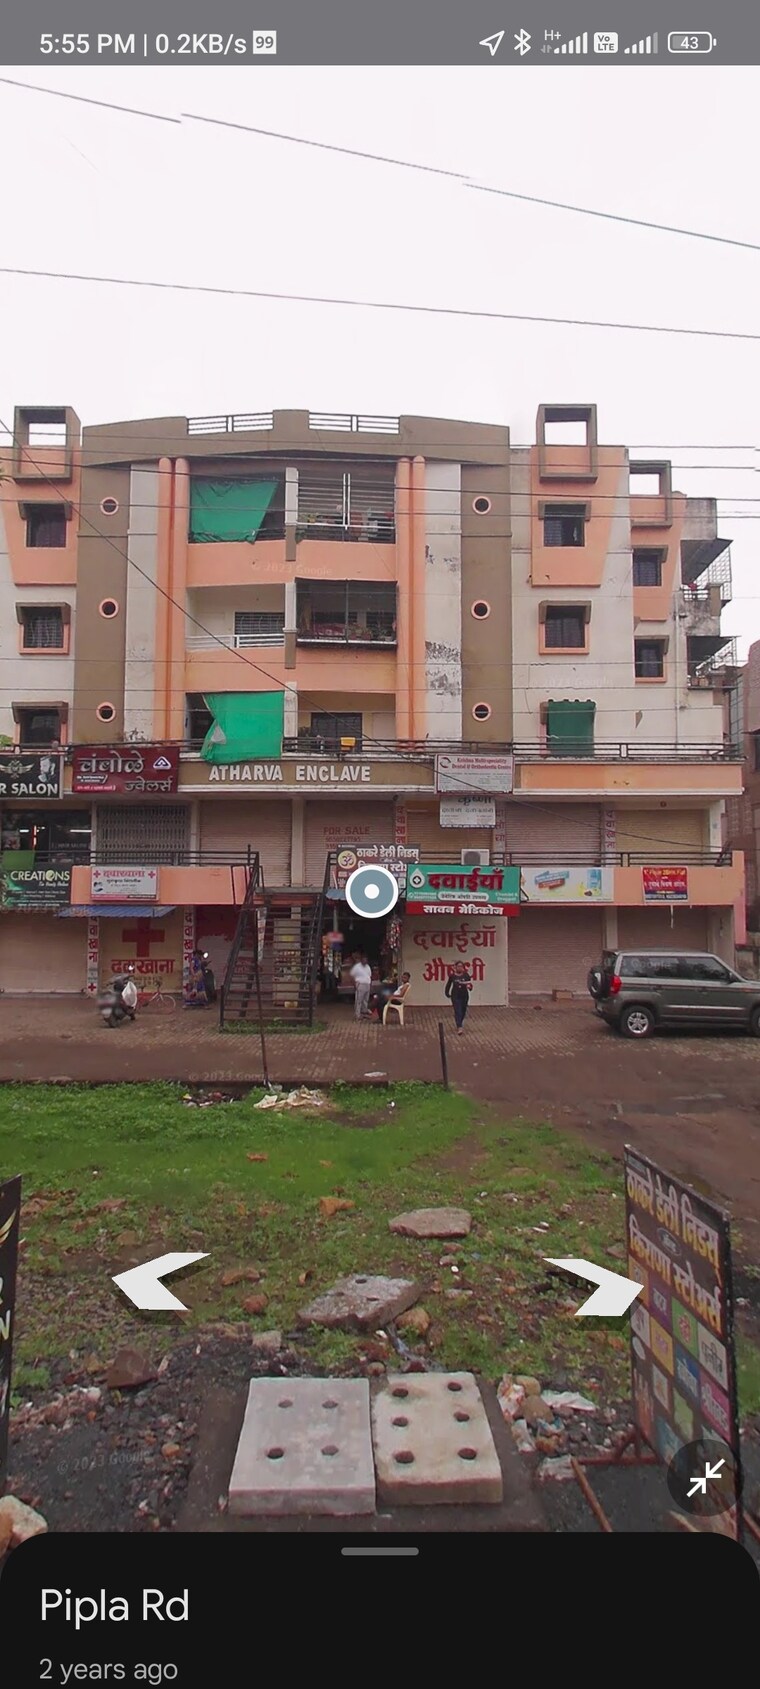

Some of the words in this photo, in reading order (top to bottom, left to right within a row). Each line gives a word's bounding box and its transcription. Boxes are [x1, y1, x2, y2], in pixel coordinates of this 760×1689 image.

[209, 764, 284, 782] ATHARVA
[295, 765, 371, 782] ENCLAVE
[11, 783, 58, 797] SALON
[323, 826, 341, 835] FOR
[344, 826, 370, 835] SALE
[356, 845, 378, 858] ठाकरे
[379, 845, 396, 858] डेली
[10, 869, 70, 881] CREATIONS
[423, 904, 455, 914] सावन
[111, 959, 176, 974] दवाखाना
[626, 1167, 655, 1216] ठाकरे
[654, 1174, 680, 1236] डेली
[629, 1214, 672, 1286] किराणा
